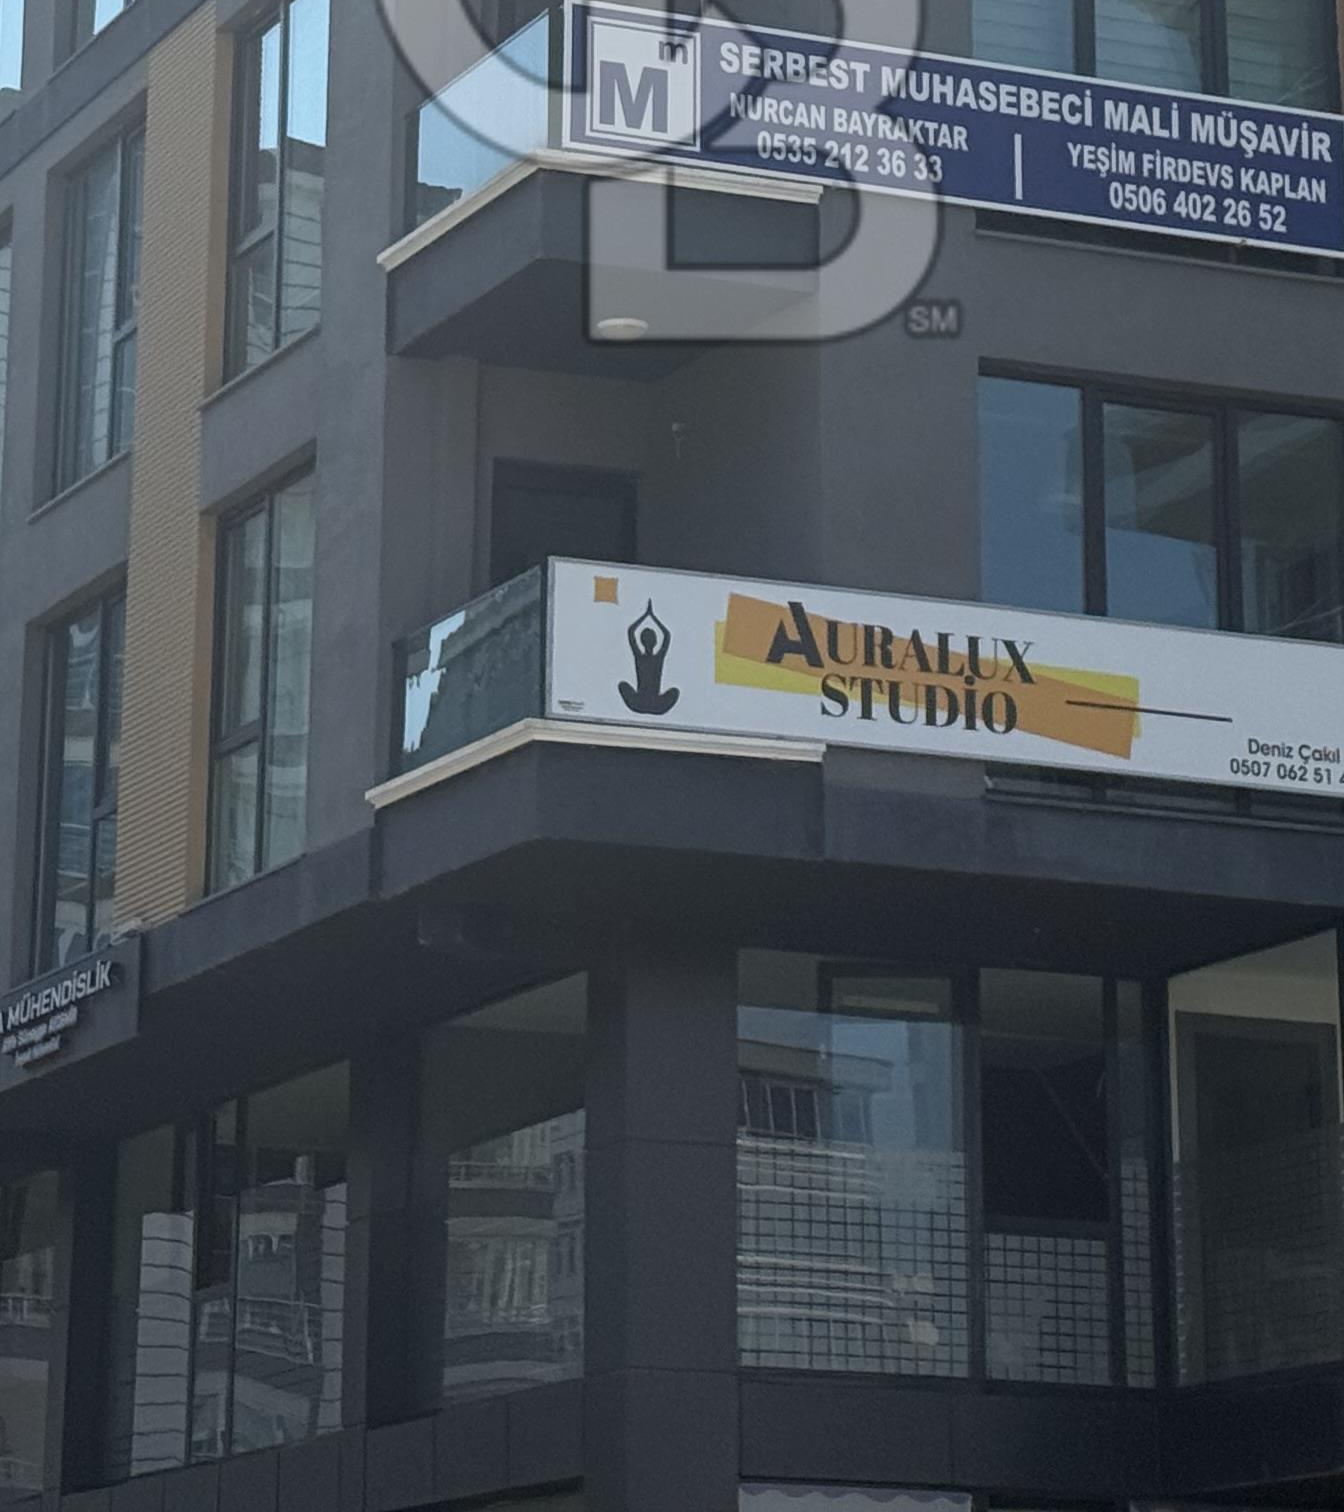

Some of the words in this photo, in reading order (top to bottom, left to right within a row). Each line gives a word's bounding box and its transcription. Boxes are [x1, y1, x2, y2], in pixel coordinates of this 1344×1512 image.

[719, 41, 870, 92] SERBEST
[880, 64, 1093, 127] MUHASEBECİ
[1104, 99, 1180, 140] MALİ
[1191, 110, 1333, 163] MÜŞAVİR
[729, 92, 826, 131] NURCAN
[833, 102, 968, 152] BAYRAKTAR
[757, 130, 817, 167] 0535
[824, 139, 869, 173] 212
[876, 149, 907, 178] 36
[913, 153, 944, 183] 33
[1067, 141, 1136, 178] YEŞİM
[1143, 148, 1234, 191] FİRDEVS
[1240, 166, 1327, 204] KAPLAN
[1109, 181, 1167, 216] 0506
[1173, 190, 1218, 223] 402
[1223, 199, 1251, 228] 26
[1258, 204, 1288, 233] 52
[765, 600, 1038, 684] AURALUX
[1230, 758, 1272, 778] 0507
[1276, 763, 1309, 783] 062
[1313, 767, 1332, 786] 51
[1248, 738, 1294, 759] Deniz
[1298, 744, 1341, 765] Çakıl
[7, 960, 112, 1030] MÜHENDİSLİK
